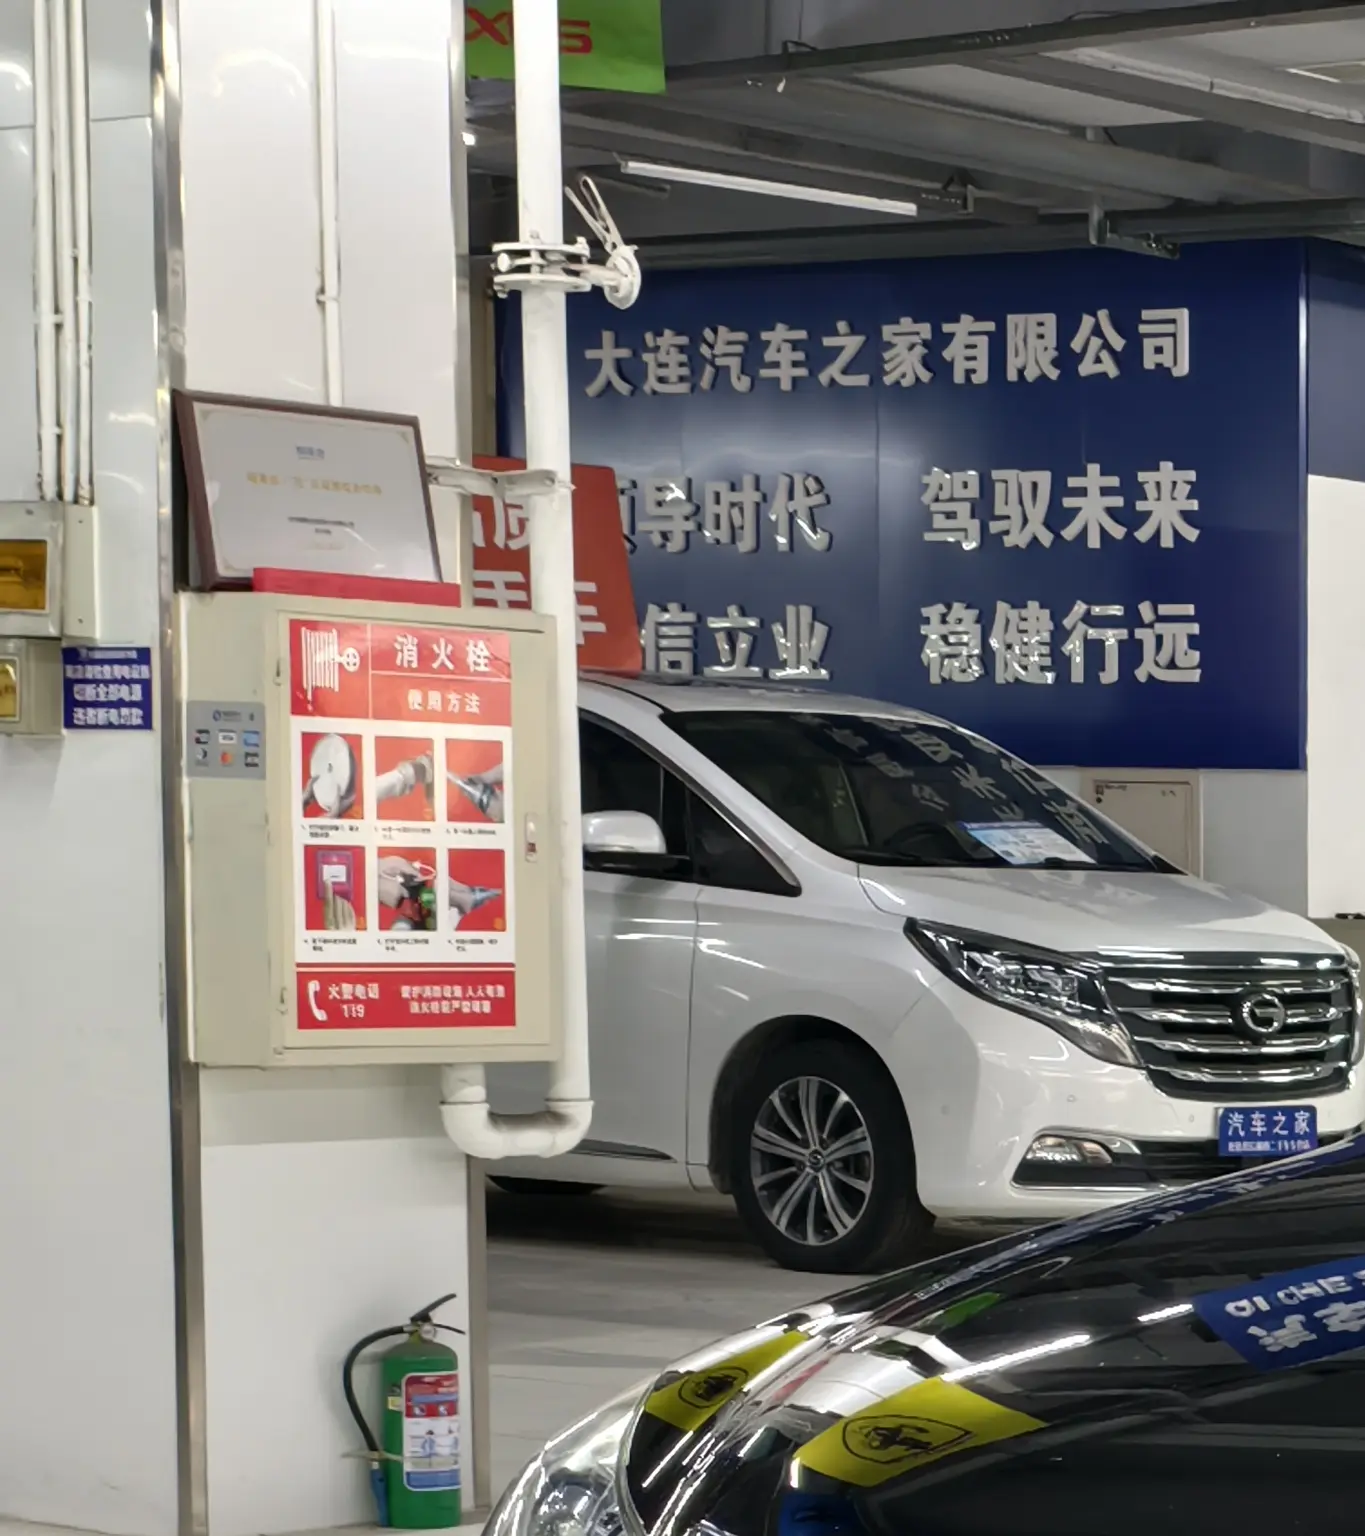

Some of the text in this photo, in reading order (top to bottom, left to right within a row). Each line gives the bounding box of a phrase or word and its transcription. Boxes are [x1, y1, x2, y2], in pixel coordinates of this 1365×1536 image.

[584, 308, 1192, 398] 大连汽车之家有限公司
[921, 461, 1201, 551] 驾驭未来
[395, 633, 492, 673] 消火栓
[921, 600, 1202, 685] 稳健行远
[1227, 1109, 1310, 1138] 汽车之家
